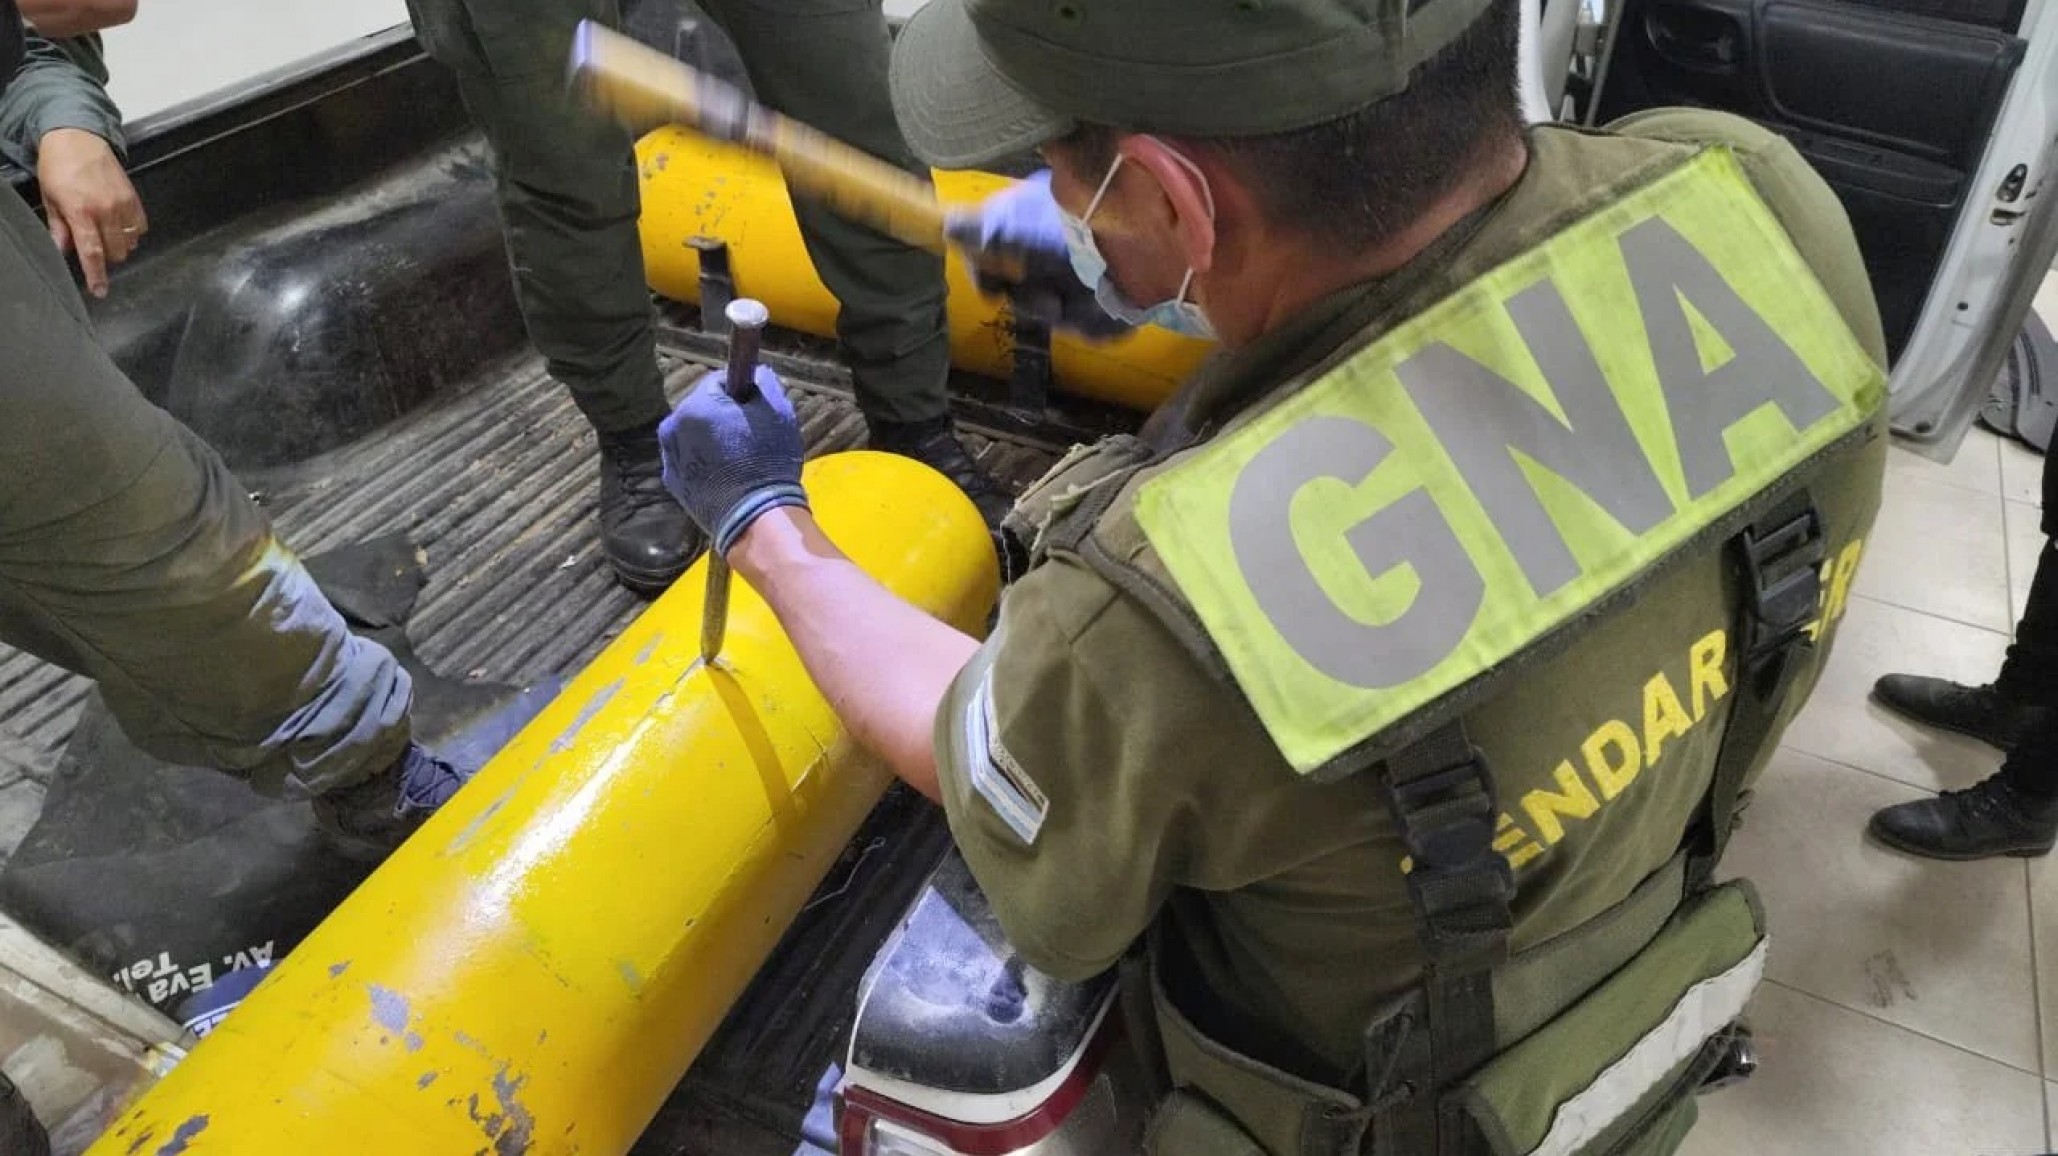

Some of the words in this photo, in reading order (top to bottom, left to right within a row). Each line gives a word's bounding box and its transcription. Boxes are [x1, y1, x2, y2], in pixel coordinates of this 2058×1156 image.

[1228, 214, 1845, 690] GNA
[113, 951, 179, 991] Tel.
[222, 940, 274, 971] Av.
[148, 962, 213, 1003] Eva
